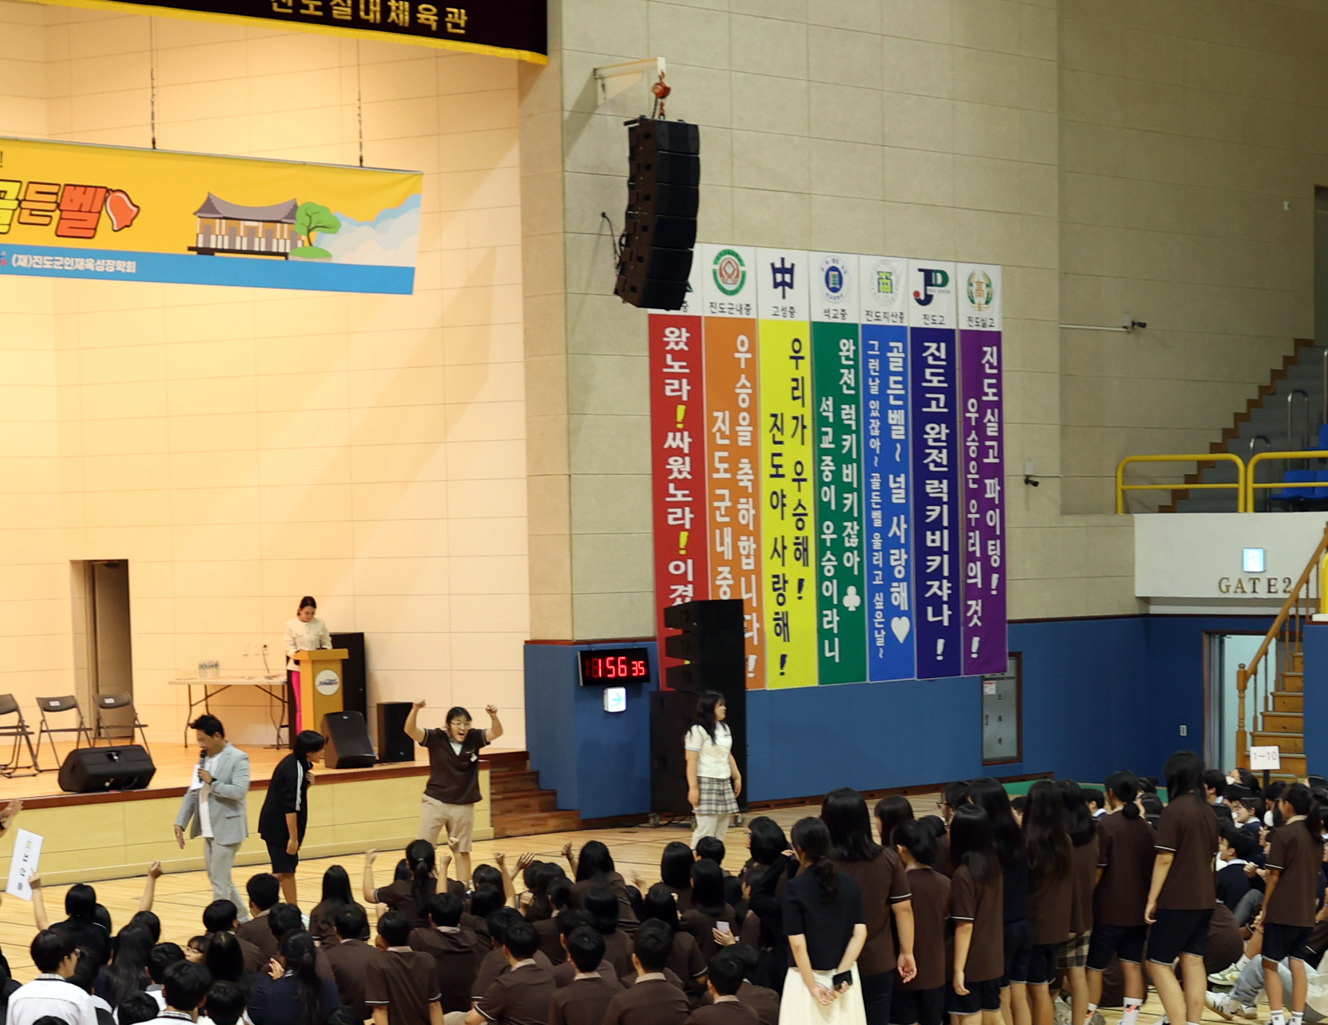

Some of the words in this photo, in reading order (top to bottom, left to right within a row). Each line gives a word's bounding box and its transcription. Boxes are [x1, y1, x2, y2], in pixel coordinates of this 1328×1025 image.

[709, 302, 752, 316] 진도군내중
[771, 306, 796, 319] 고성중
[824, 308, 847, 321] 석교중
[922, 313, 945, 326] 진도고
[733, 334, 754, 446] 우승을
[789, 338, 807, 445] 우리가
[838, 339, 856, 394] 완전
[921, 342, 949, 412] 진도고
[981, 346, 1000, 463] 진도실고
[769, 412, 787, 520] 진도야
[819, 396, 836, 510] 석교중이
[922, 423, 949, 471] 완전
[965, 398, 979, 488] 우승은
[712, 411, 734, 600] 진도군내중
[870, 473, 882, 527] 골든벨
[889, 473, 906, 504] 널
[888, 514, 909, 611] 사랑해
[966, 499, 982, 588] 우리의
[984, 477, 1001, 595] 파이팅!
[821, 521, 840, 663] 우승이라니
